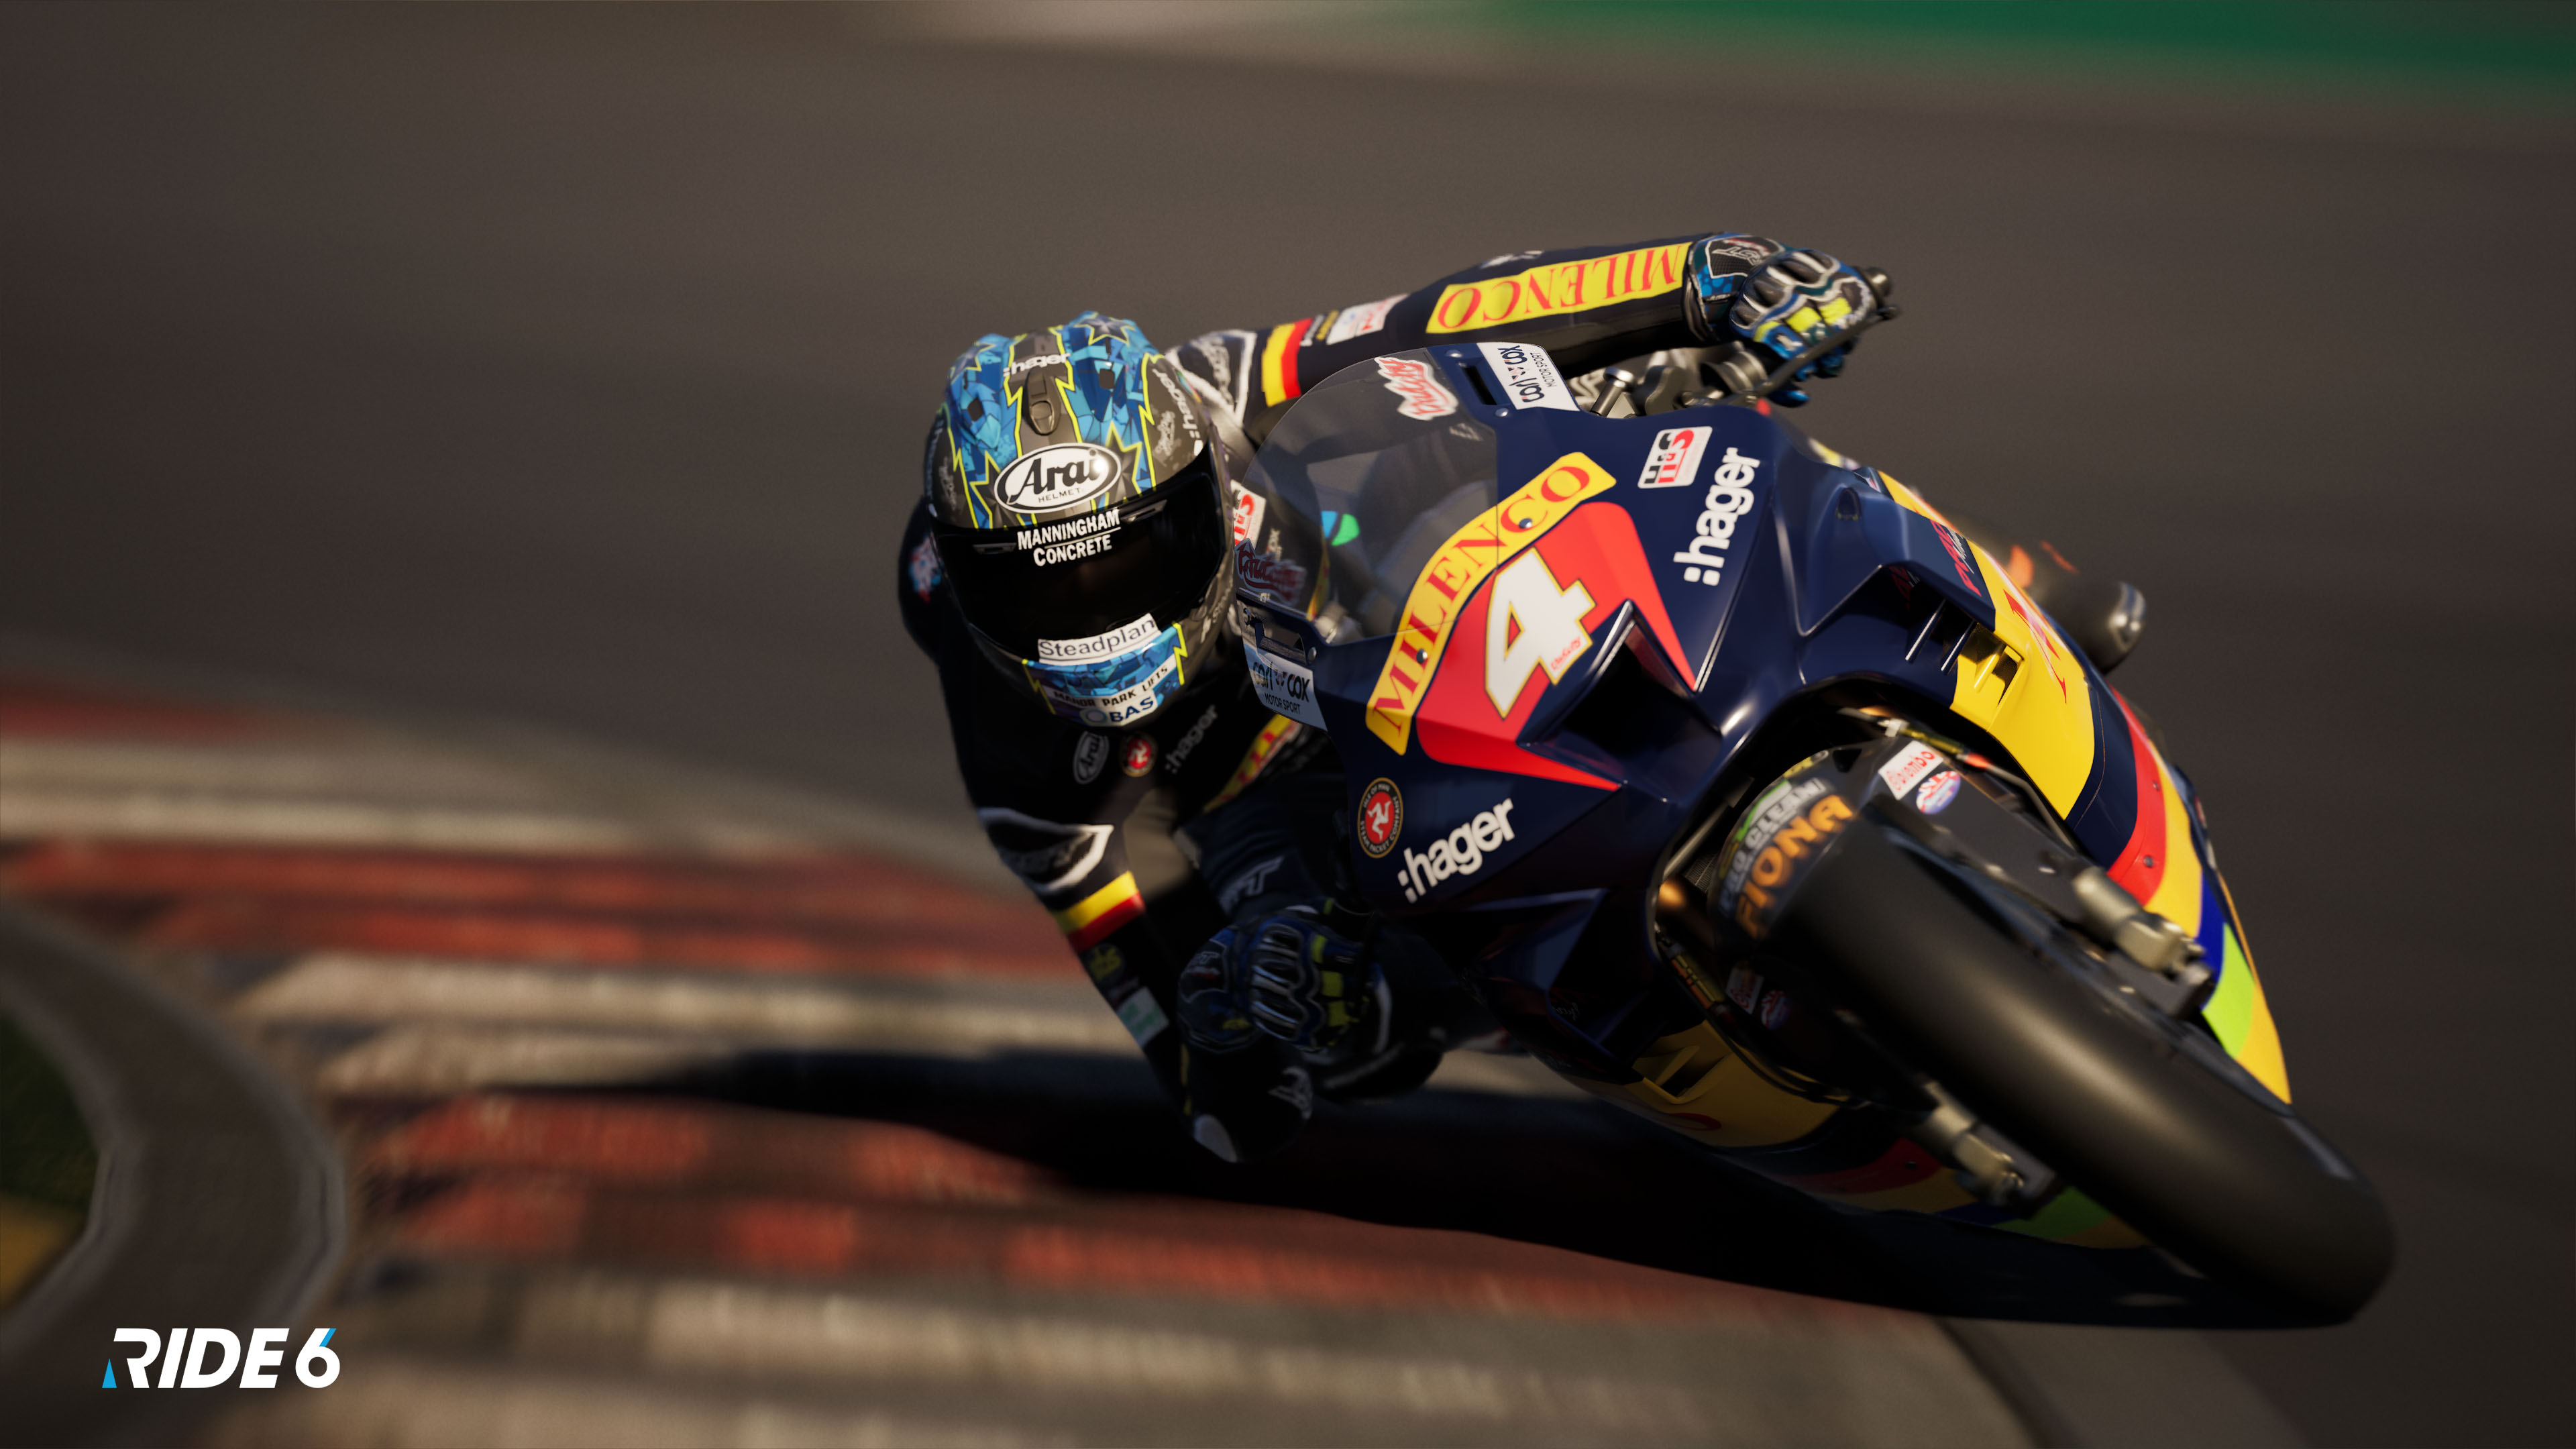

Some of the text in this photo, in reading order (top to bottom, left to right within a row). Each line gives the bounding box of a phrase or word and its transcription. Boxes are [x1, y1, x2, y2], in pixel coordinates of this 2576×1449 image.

[1438, 246, 1684, 329] MILENCO
[1529, 352, 1556, 387] MOTOR SPORT
[1007, 448, 1104, 504] Arai
[1038, 487, 1081, 502] HELMET
[1017, 509, 1120, 551] MANNINGHAM
[1033, 535, 1113, 566] CONCRETE
[1372, 466, 1591, 737] MILENCO
[1040, 619, 1155, 657] Steadplan
[1485, 546, 1597, 720] 4
[1053, 667, 1168, 707] MANOR PARK LIFTS
[1264, 693, 1301, 715] MOTOR SPORT
[1736, 794, 1853, 938] FIONA
